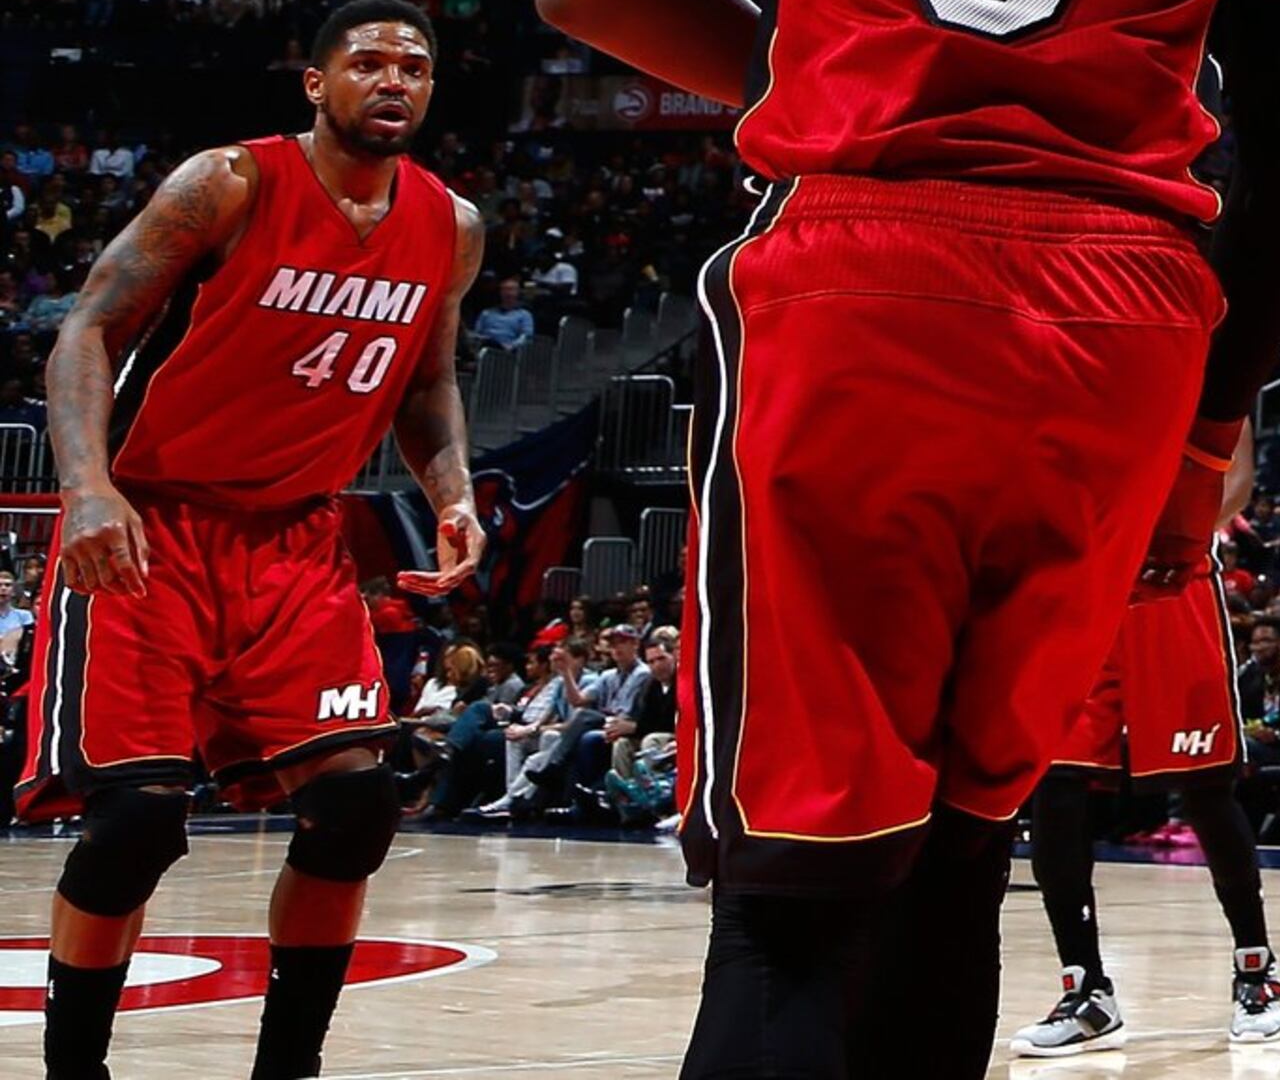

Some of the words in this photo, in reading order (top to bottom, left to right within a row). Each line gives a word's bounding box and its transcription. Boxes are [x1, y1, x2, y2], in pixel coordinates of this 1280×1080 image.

[659, 93, 722, 114] BRAND
[258, 267, 428, 325] MIAMI
[292, 331, 398, 394] 40
